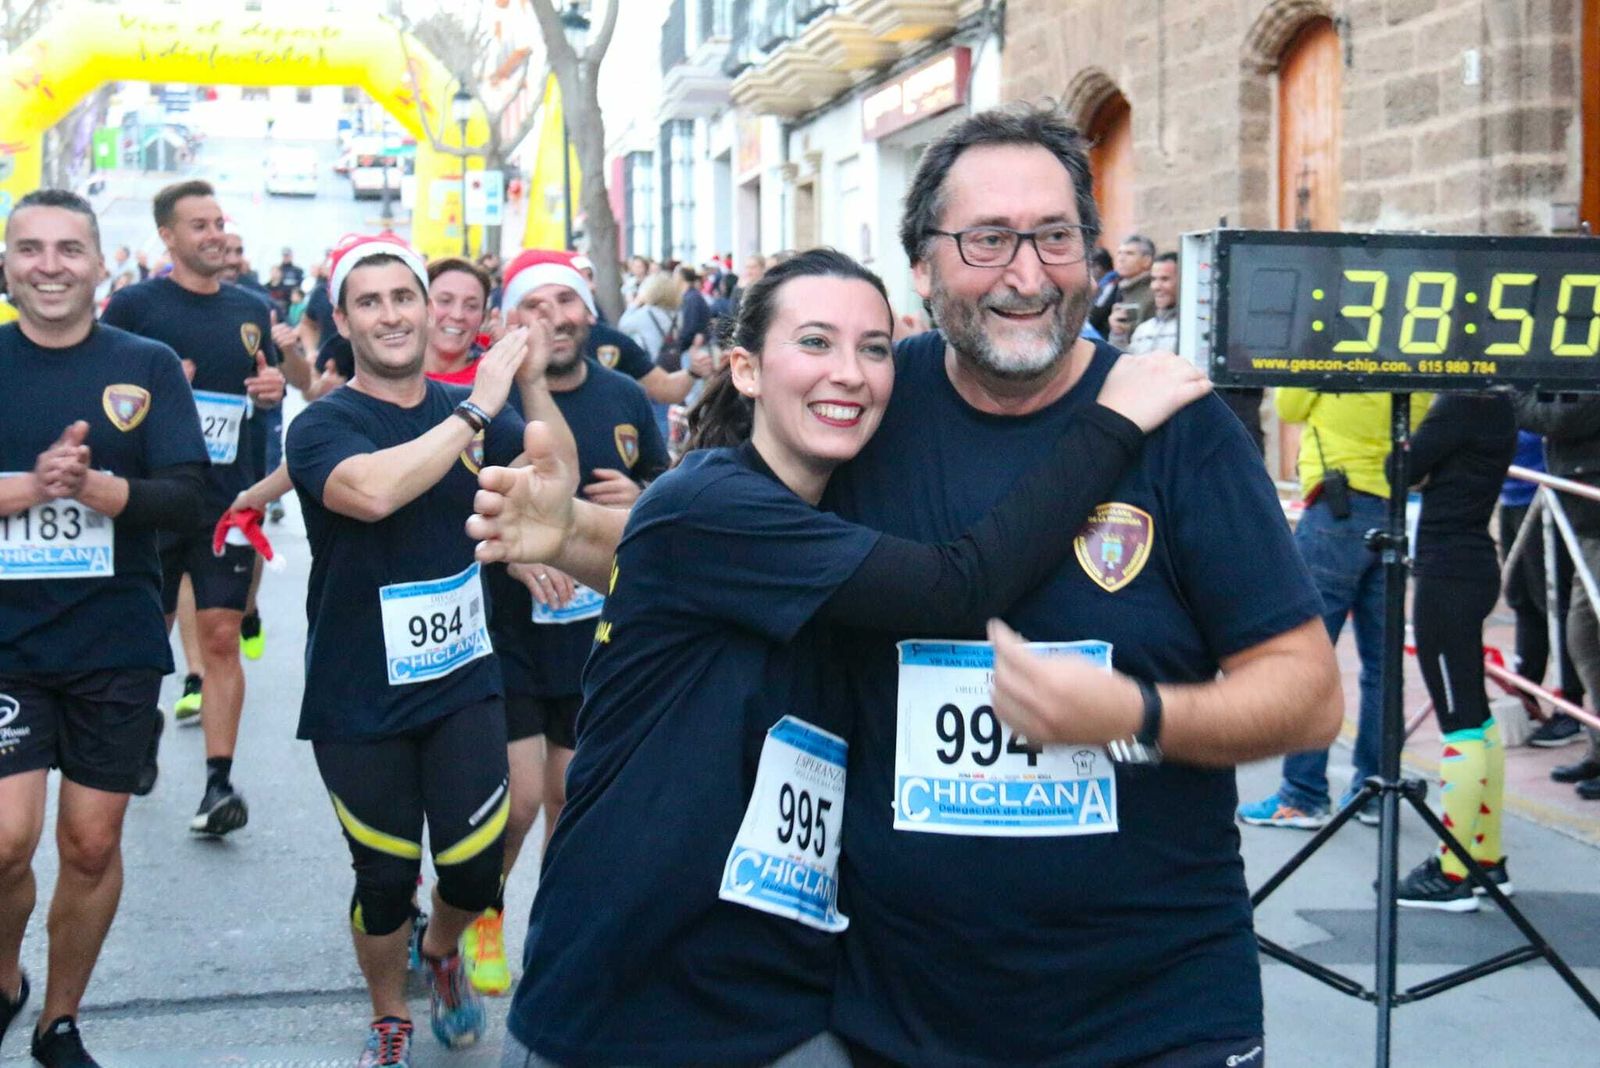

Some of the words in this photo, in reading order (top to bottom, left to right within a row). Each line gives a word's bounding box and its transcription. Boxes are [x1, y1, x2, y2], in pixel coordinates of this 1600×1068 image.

[0, 547, 109, 572] HICLANA
[408, 606, 463, 648] 984
[391, 629, 488, 680] CHICLANA
[963, 658, 993, 669] SILVE
[778, 783, 832, 858] 995
[901, 777, 1112, 826] CHICLANA
[938, 803, 1000, 816] Delegación
[1003, 806, 1019, 816] de
[1021, 805, 1074, 817] Deportes
